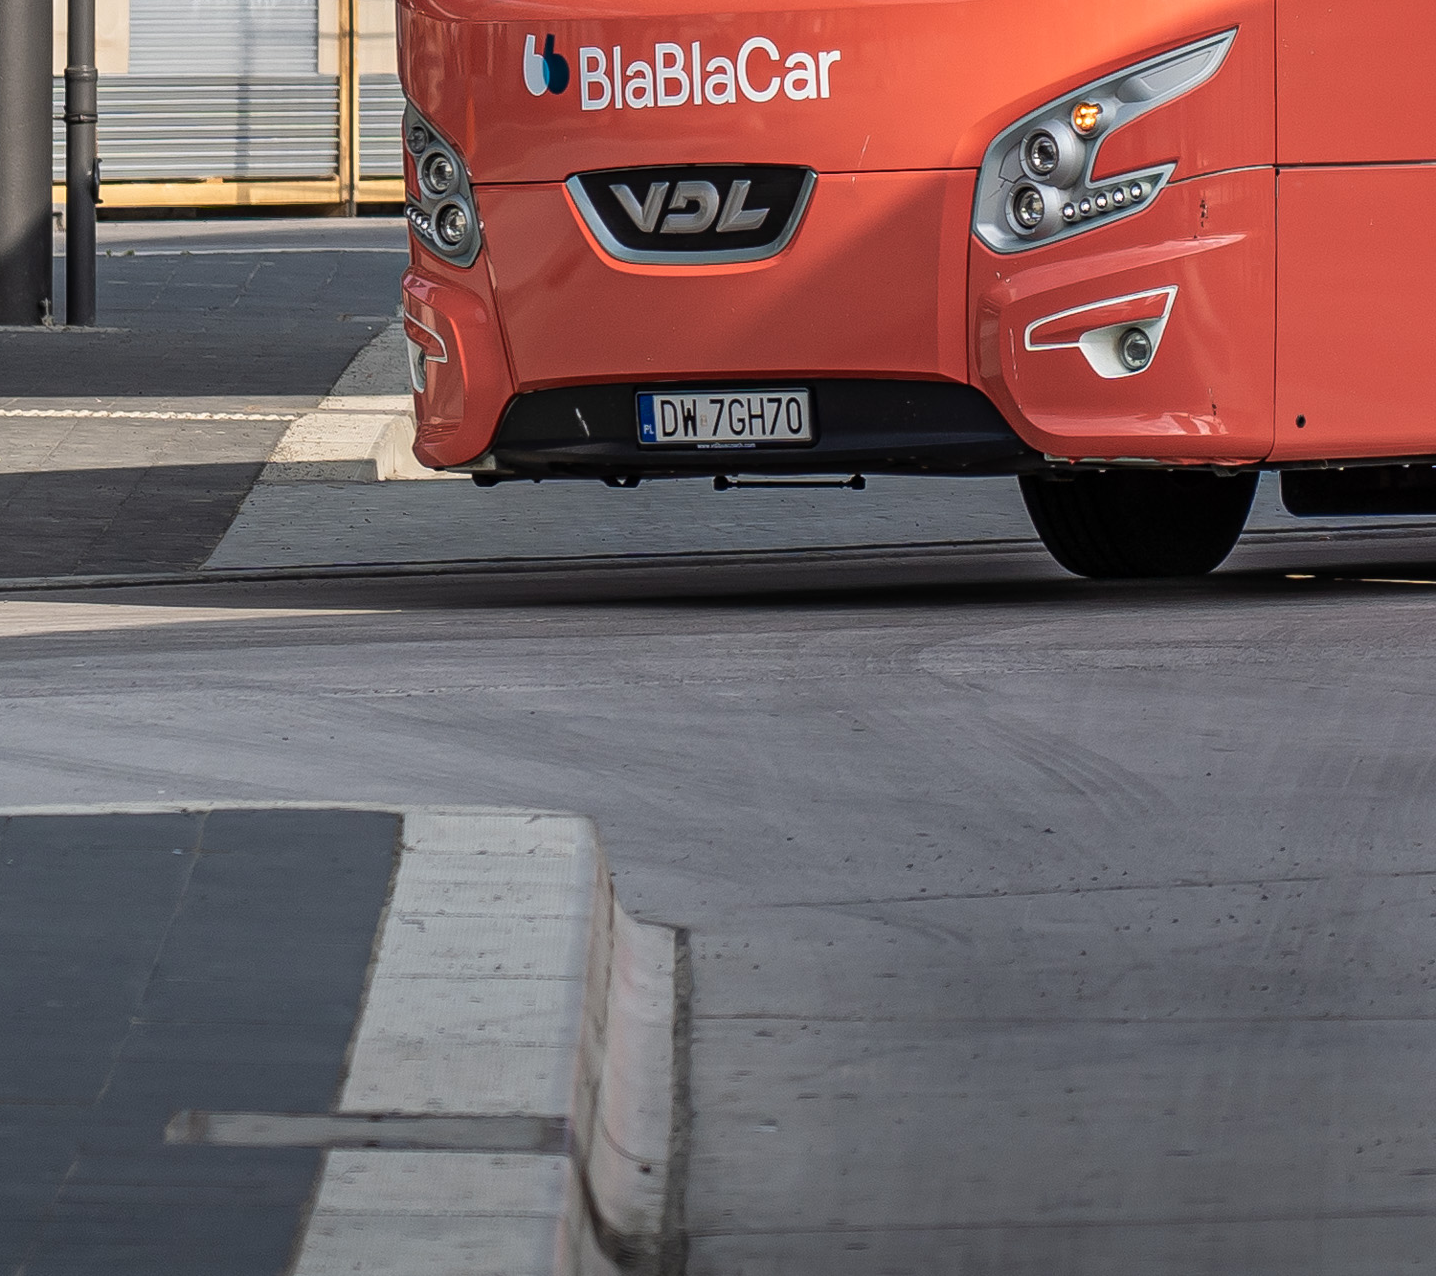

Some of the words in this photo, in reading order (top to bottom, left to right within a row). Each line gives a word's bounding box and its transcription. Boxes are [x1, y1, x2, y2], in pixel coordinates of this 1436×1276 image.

[579, 36, 841, 111] BlaBlaCar
[609, 179, 770, 234] VDL
[643, 423, 655, 435] PL
[660, 398, 698, 437] DW
[709, 396, 803, 437] 7GH70
